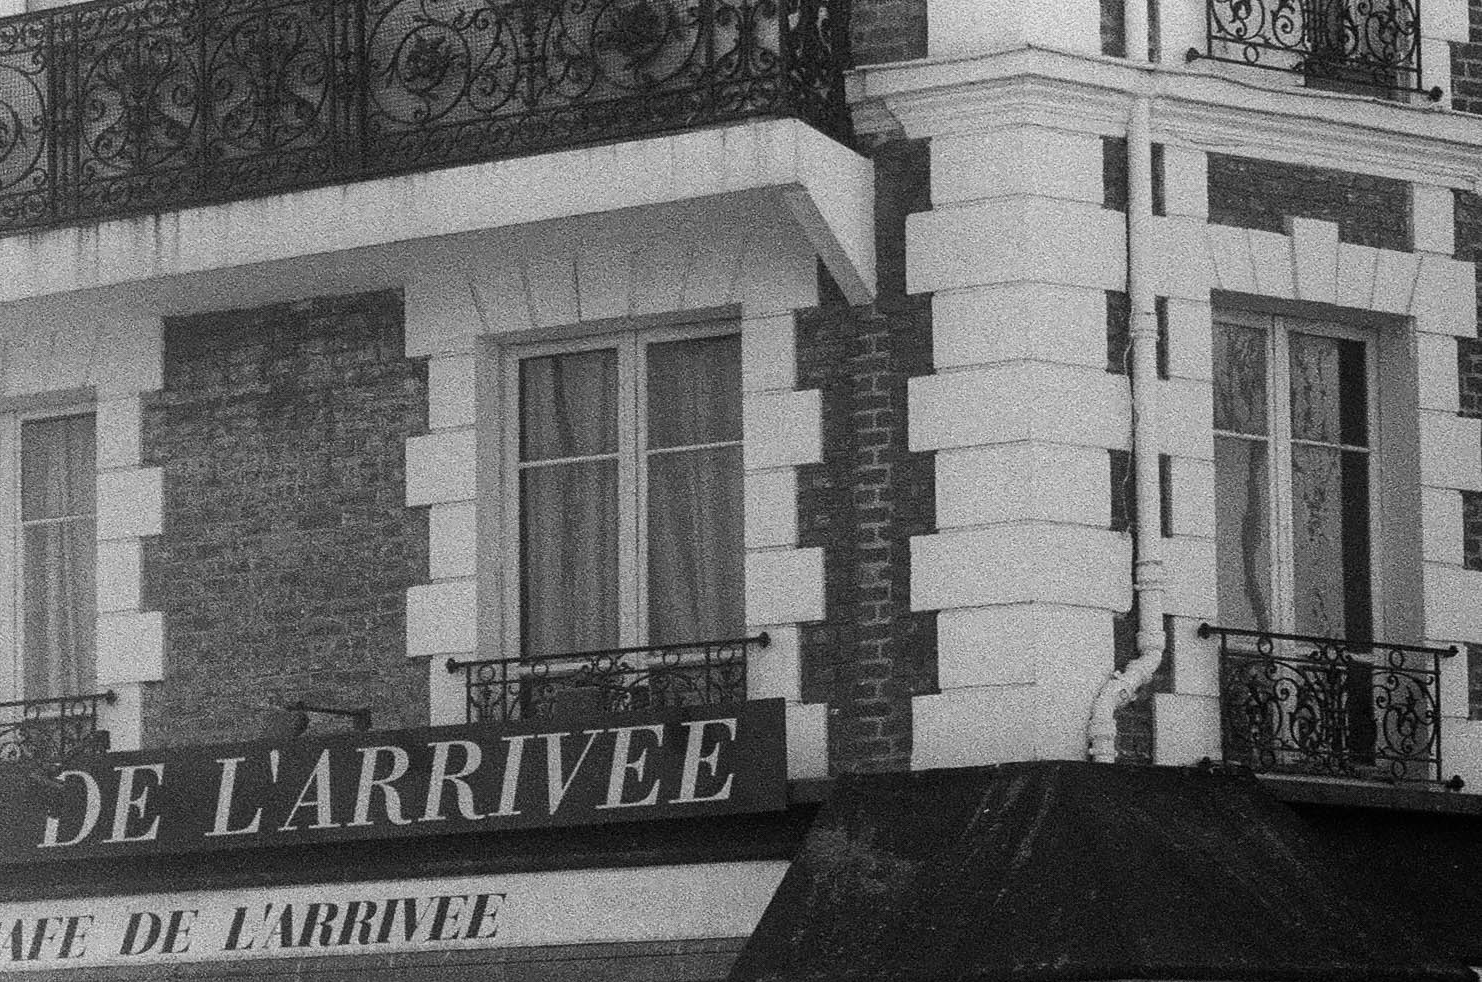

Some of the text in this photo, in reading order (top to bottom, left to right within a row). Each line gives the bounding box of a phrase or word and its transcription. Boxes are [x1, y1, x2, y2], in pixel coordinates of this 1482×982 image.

[36, 762, 166, 849] DE
[204, 717, 739, 838] L'ARRIVEE
[119, 907, 199, 956] DE
[224, 892, 508, 951] L'ARRIVEE
